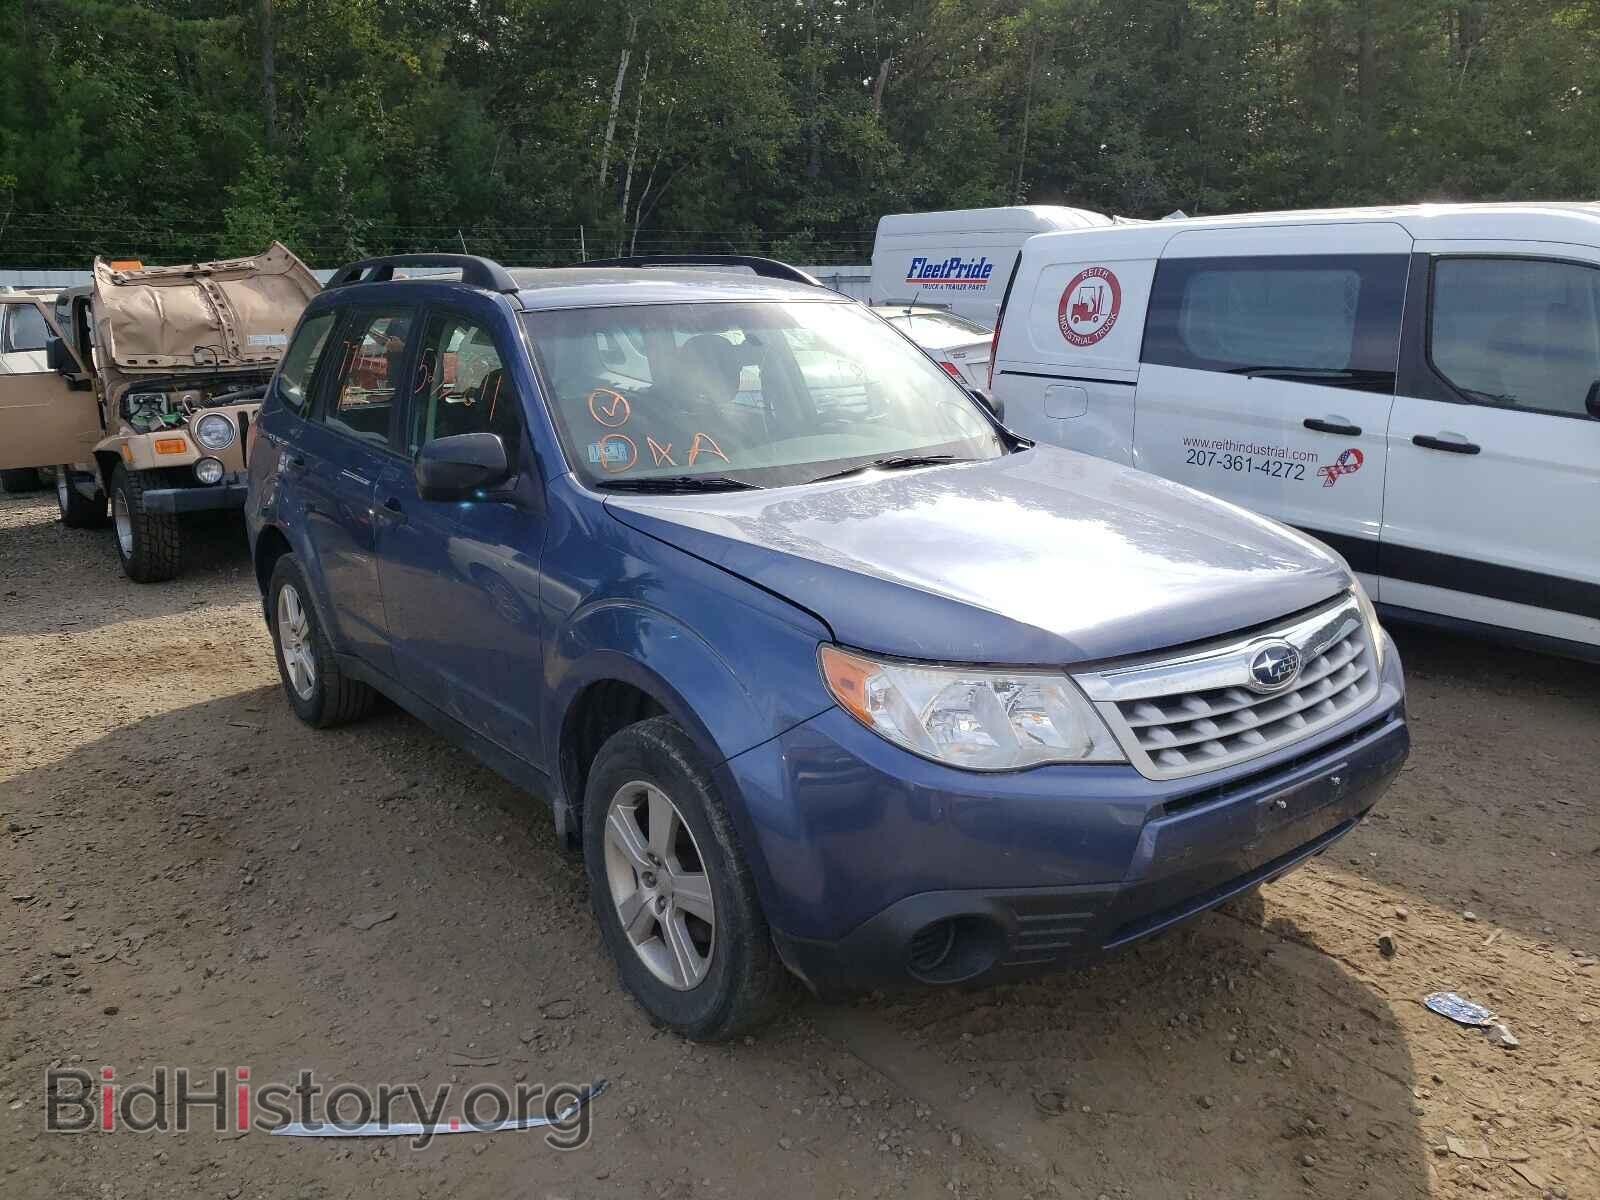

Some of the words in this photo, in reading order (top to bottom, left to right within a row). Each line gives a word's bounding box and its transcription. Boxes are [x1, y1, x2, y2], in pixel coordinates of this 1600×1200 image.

[907, 257, 993, 279] FleetPride
[1082, 268, 1109, 279] REITH
[1059, 313, 1093, 345] INDUSTRIAL
[1094, 312, 1117, 340] TRUCK
[1183, 436, 1319, 463] www.reithindustrial.com
[1186, 448, 1306, 481] 207-361-4272
